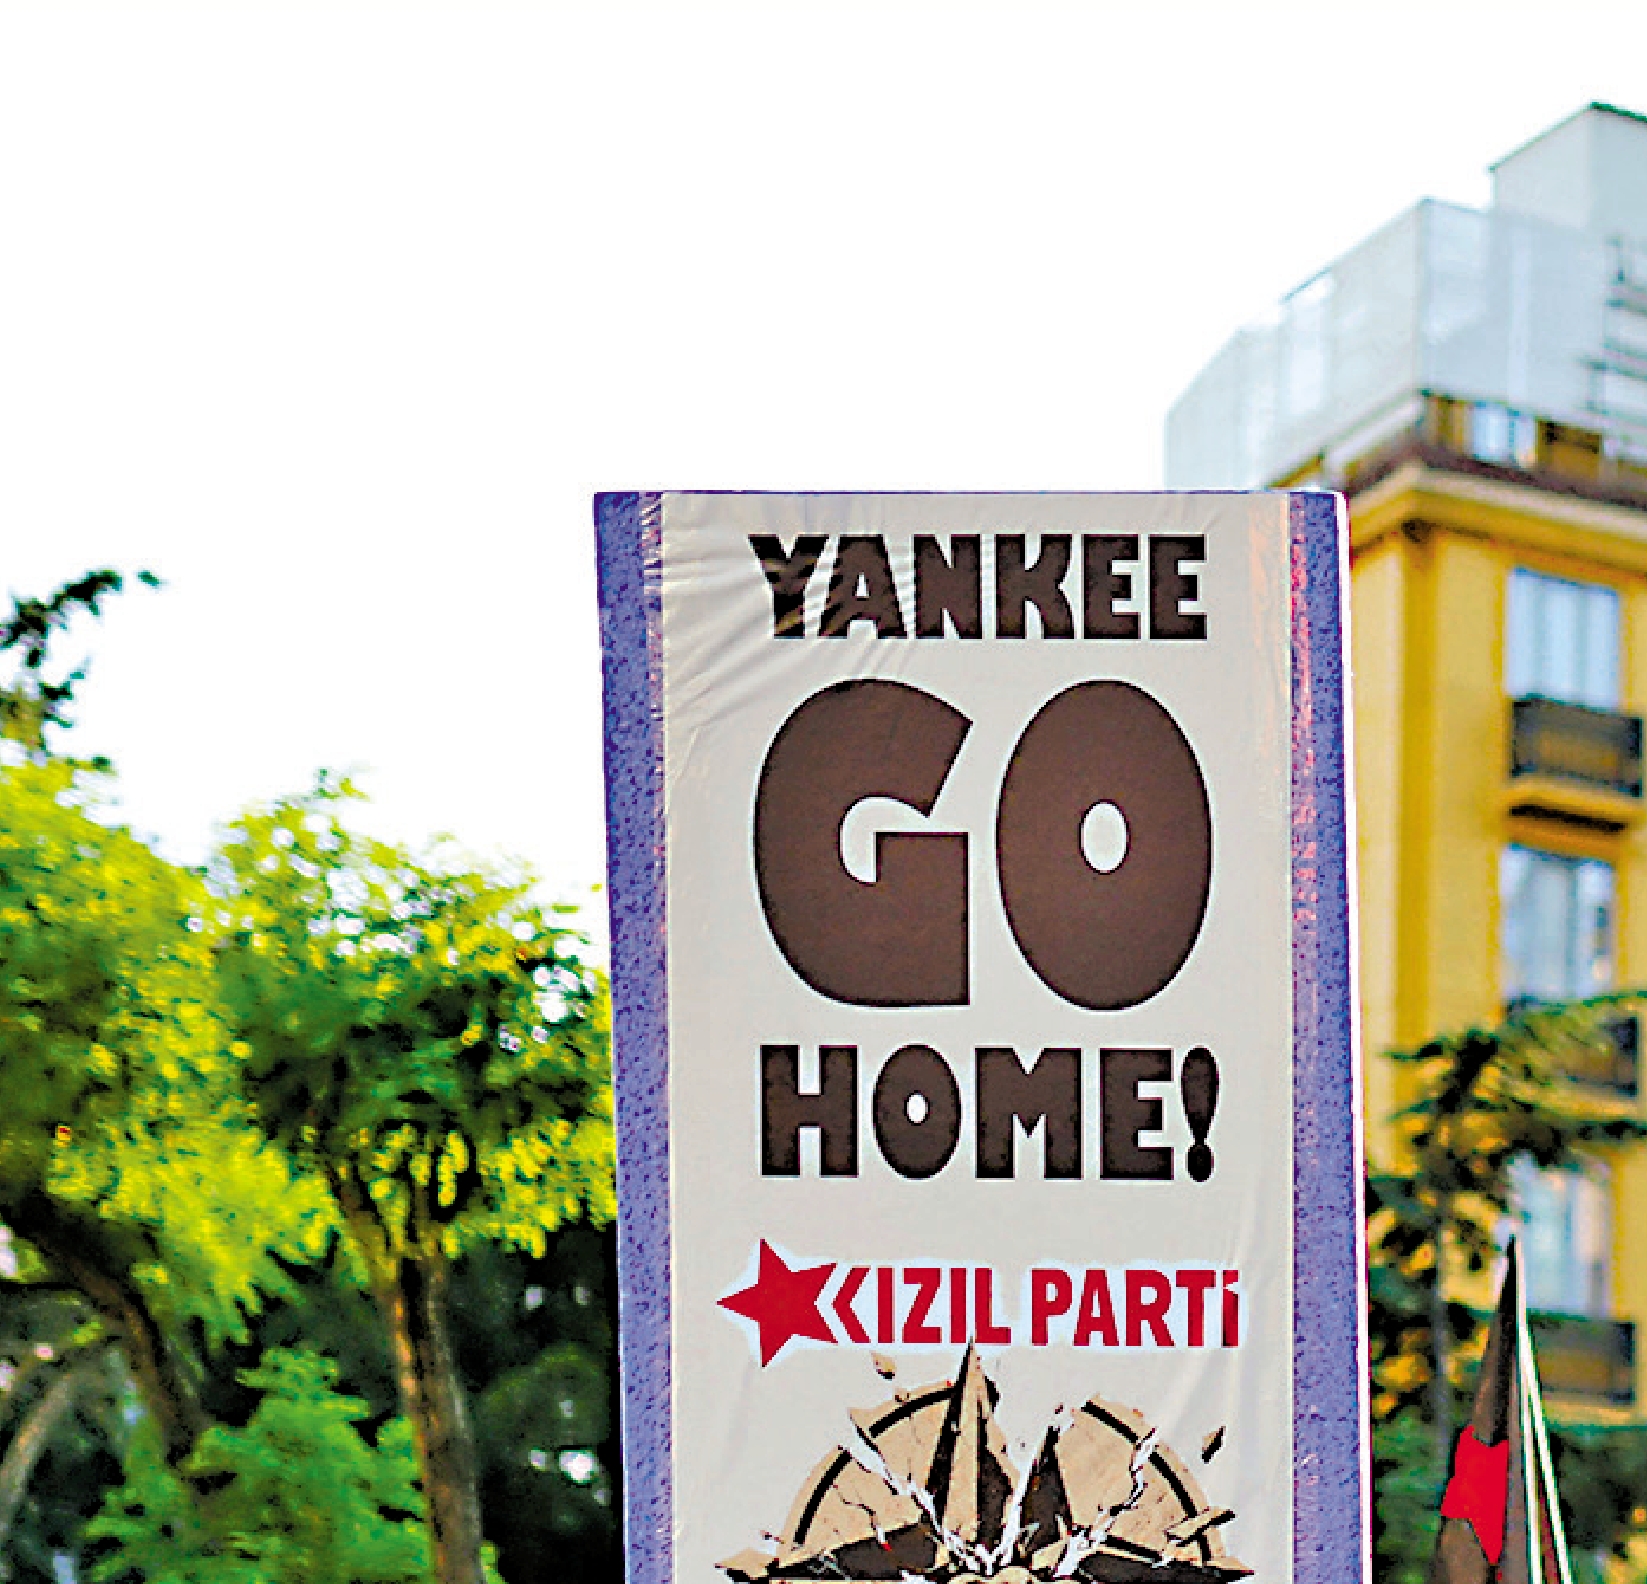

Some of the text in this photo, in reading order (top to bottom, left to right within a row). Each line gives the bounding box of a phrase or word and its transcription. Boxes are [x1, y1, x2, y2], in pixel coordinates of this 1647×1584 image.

[748, 533, 1207, 640] YANKEE
[753, 678, 1212, 1011] GO
[760, 1043, 1220, 1183] HOME!
